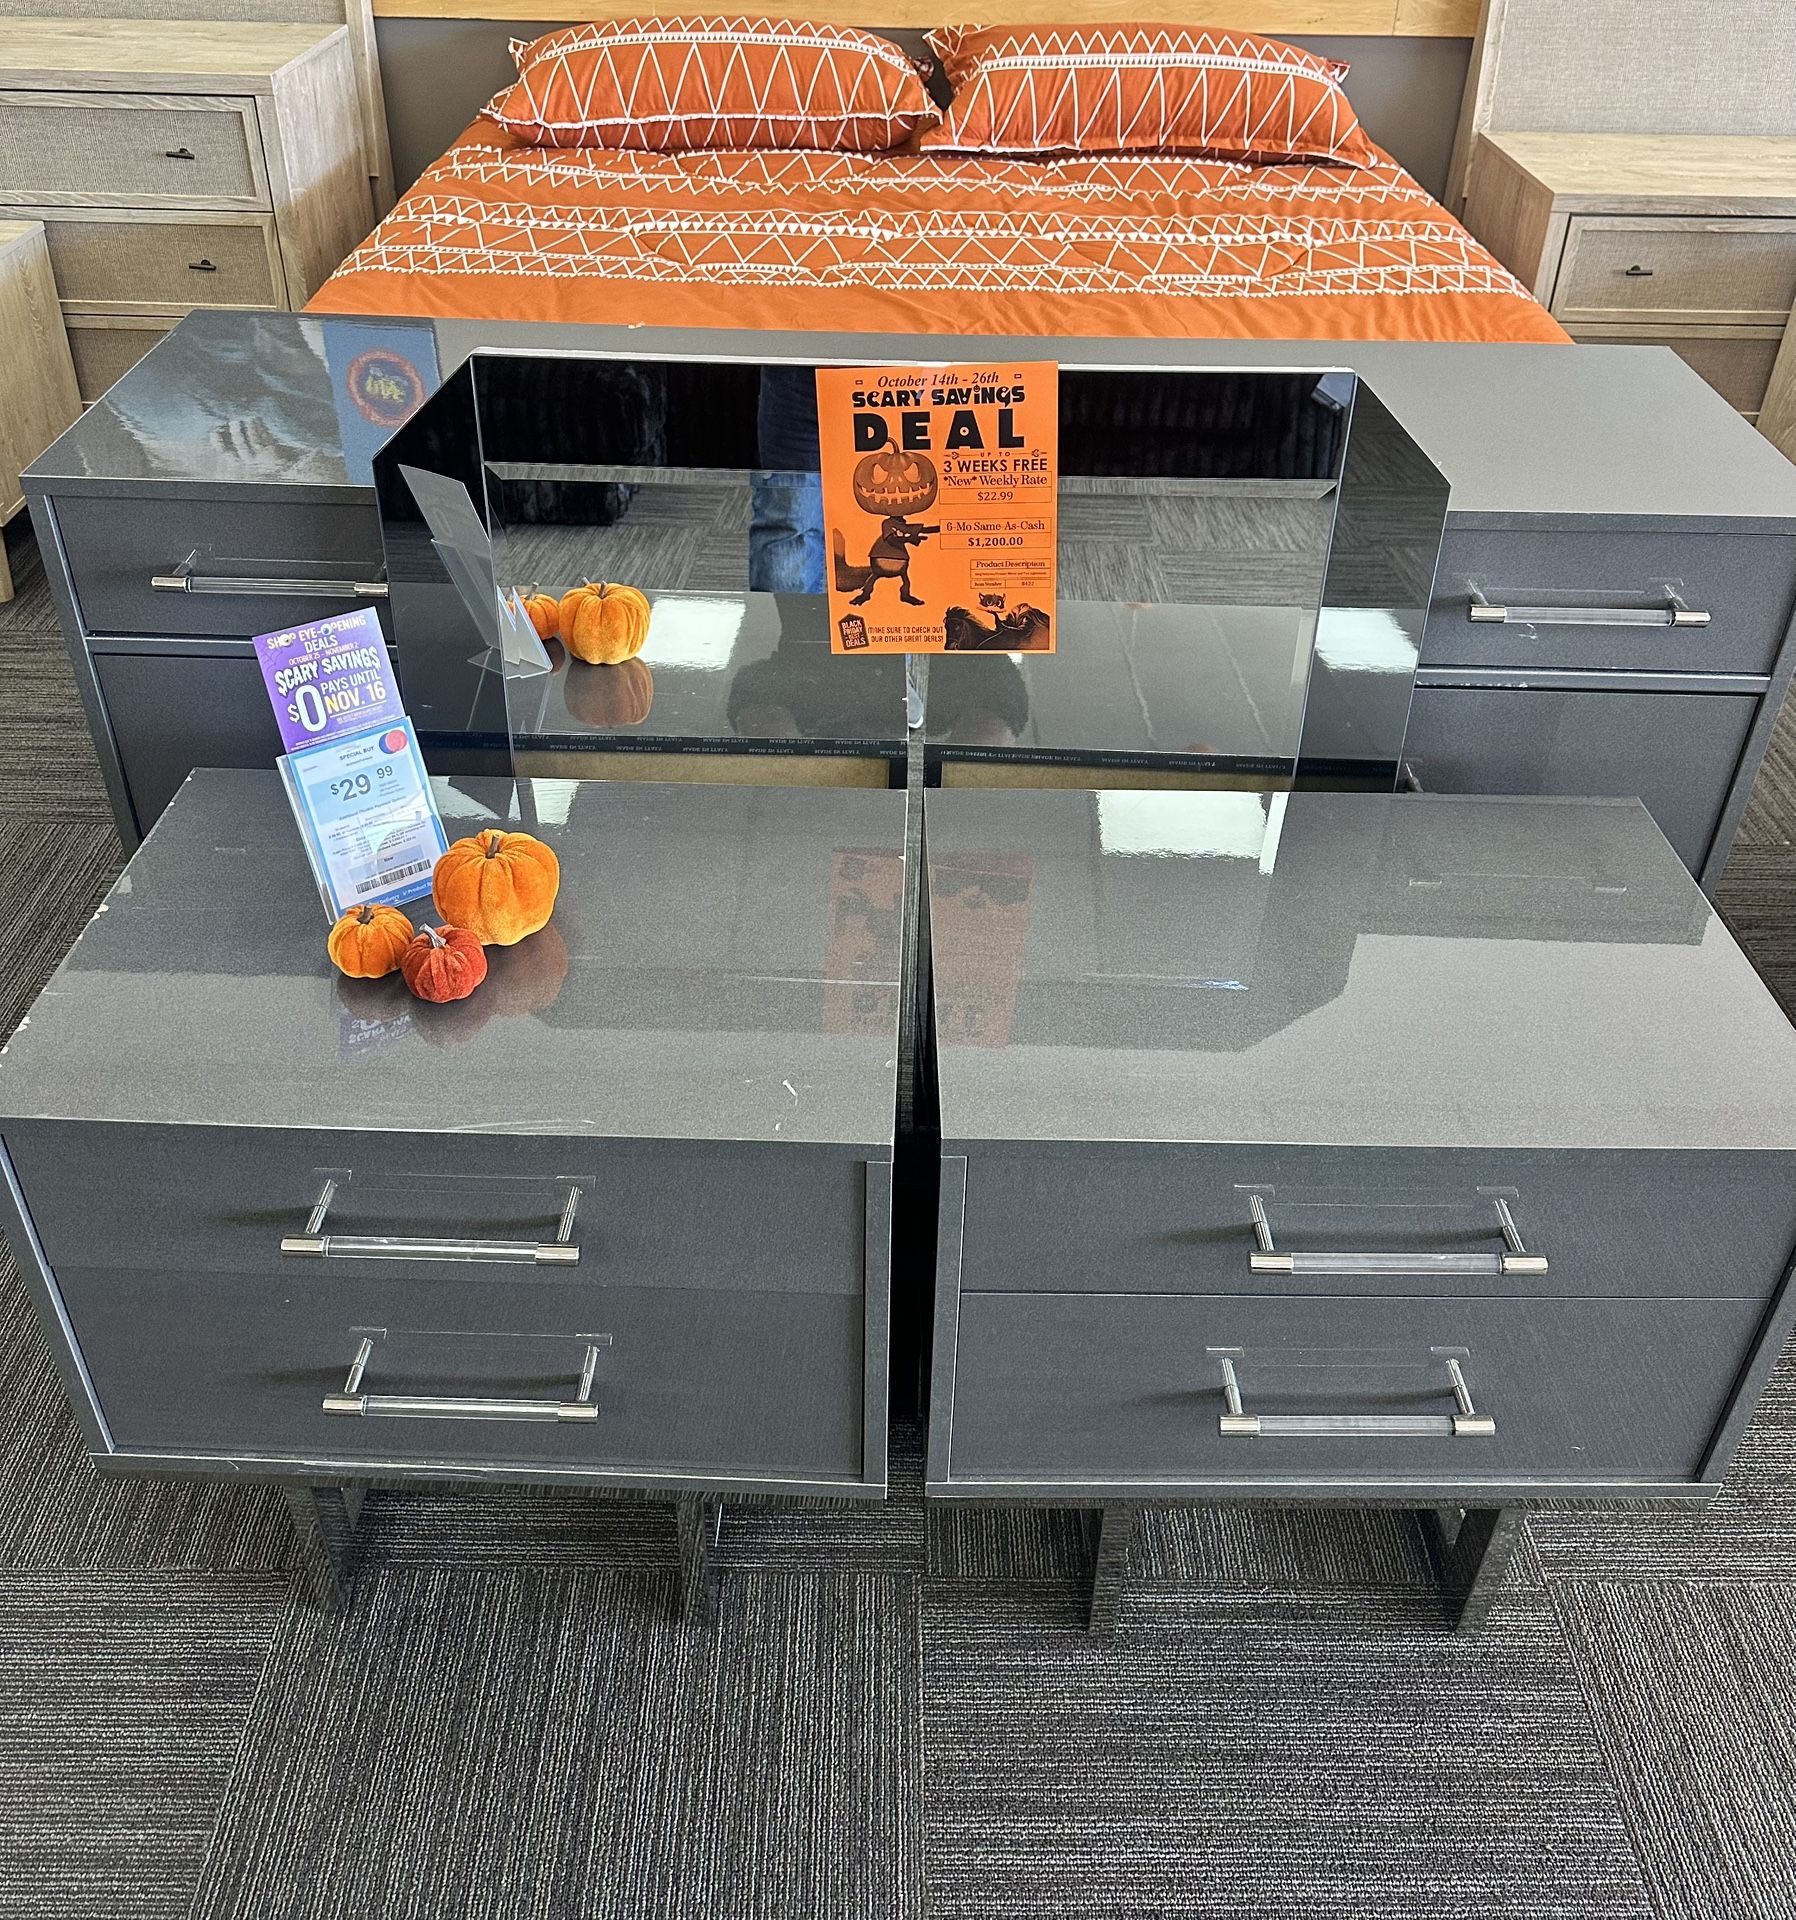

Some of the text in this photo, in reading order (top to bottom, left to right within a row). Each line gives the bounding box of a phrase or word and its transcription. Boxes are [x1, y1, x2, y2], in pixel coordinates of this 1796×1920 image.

[878, 375, 928, 388] October
[931, 374, 958, 386] 14th
[972, 372, 999, 384] 26th
[852, 390, 924, 408] SCARY
[853, 408, 1025, 452] DEAL
[943, 458, 1048, 473] 3 WEEKS FREE
[979, 475, 1020, 488] Weekly
[1021, 474, 1048, 485] Rate
[977, 491, 1013, 501] $22.99
[968, 537, 1024, 547] $1,200.00
[1005, 560, 1046, 569] Description
[266, 615, 366, 650] SHOP EYE-OPENING
[841, 620, 863, 630] BLACK
[304, 635, 338, 653] DEALS
[845, 637, 866, 648] DEALS
[288, 653, 314, 665] OCTOBER
[274, 662, 319, 697] SCARY
[287, 684, 327, 732] $0
[320, 677, 349, 695] PAYS
[350, 669, 381, 688] UNTIL
[325, 681, 386, 715] NOV. 16
[339, 749, 362, 760] SPECIAL
[362, 745, 375, 755] BUY
[330, 773, 371, 801] $29
[376, 765, 393, 779] 99
